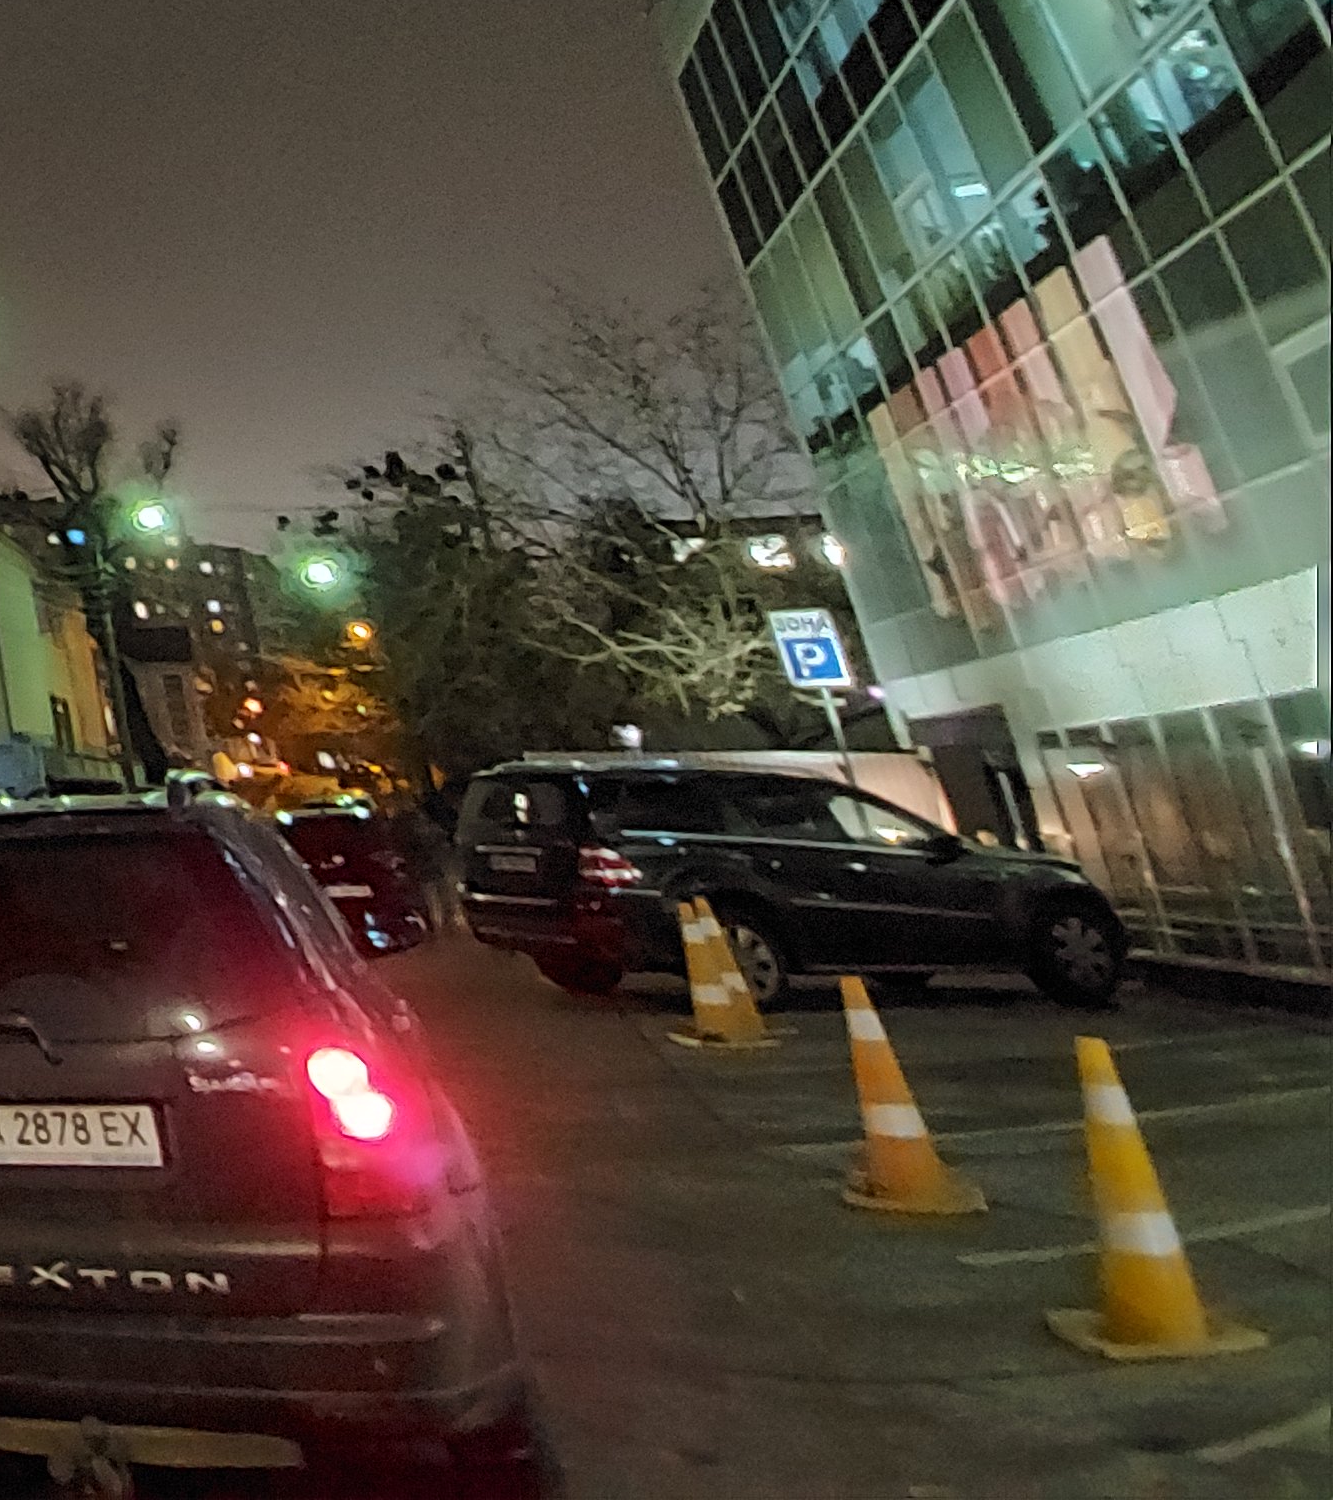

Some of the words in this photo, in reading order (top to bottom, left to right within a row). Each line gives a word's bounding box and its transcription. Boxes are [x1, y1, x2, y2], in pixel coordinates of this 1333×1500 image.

[794, 642, 827, 677] P
[13, 1111, 91, 1146] 2878
[99, 1111, 147, 1146] EX
